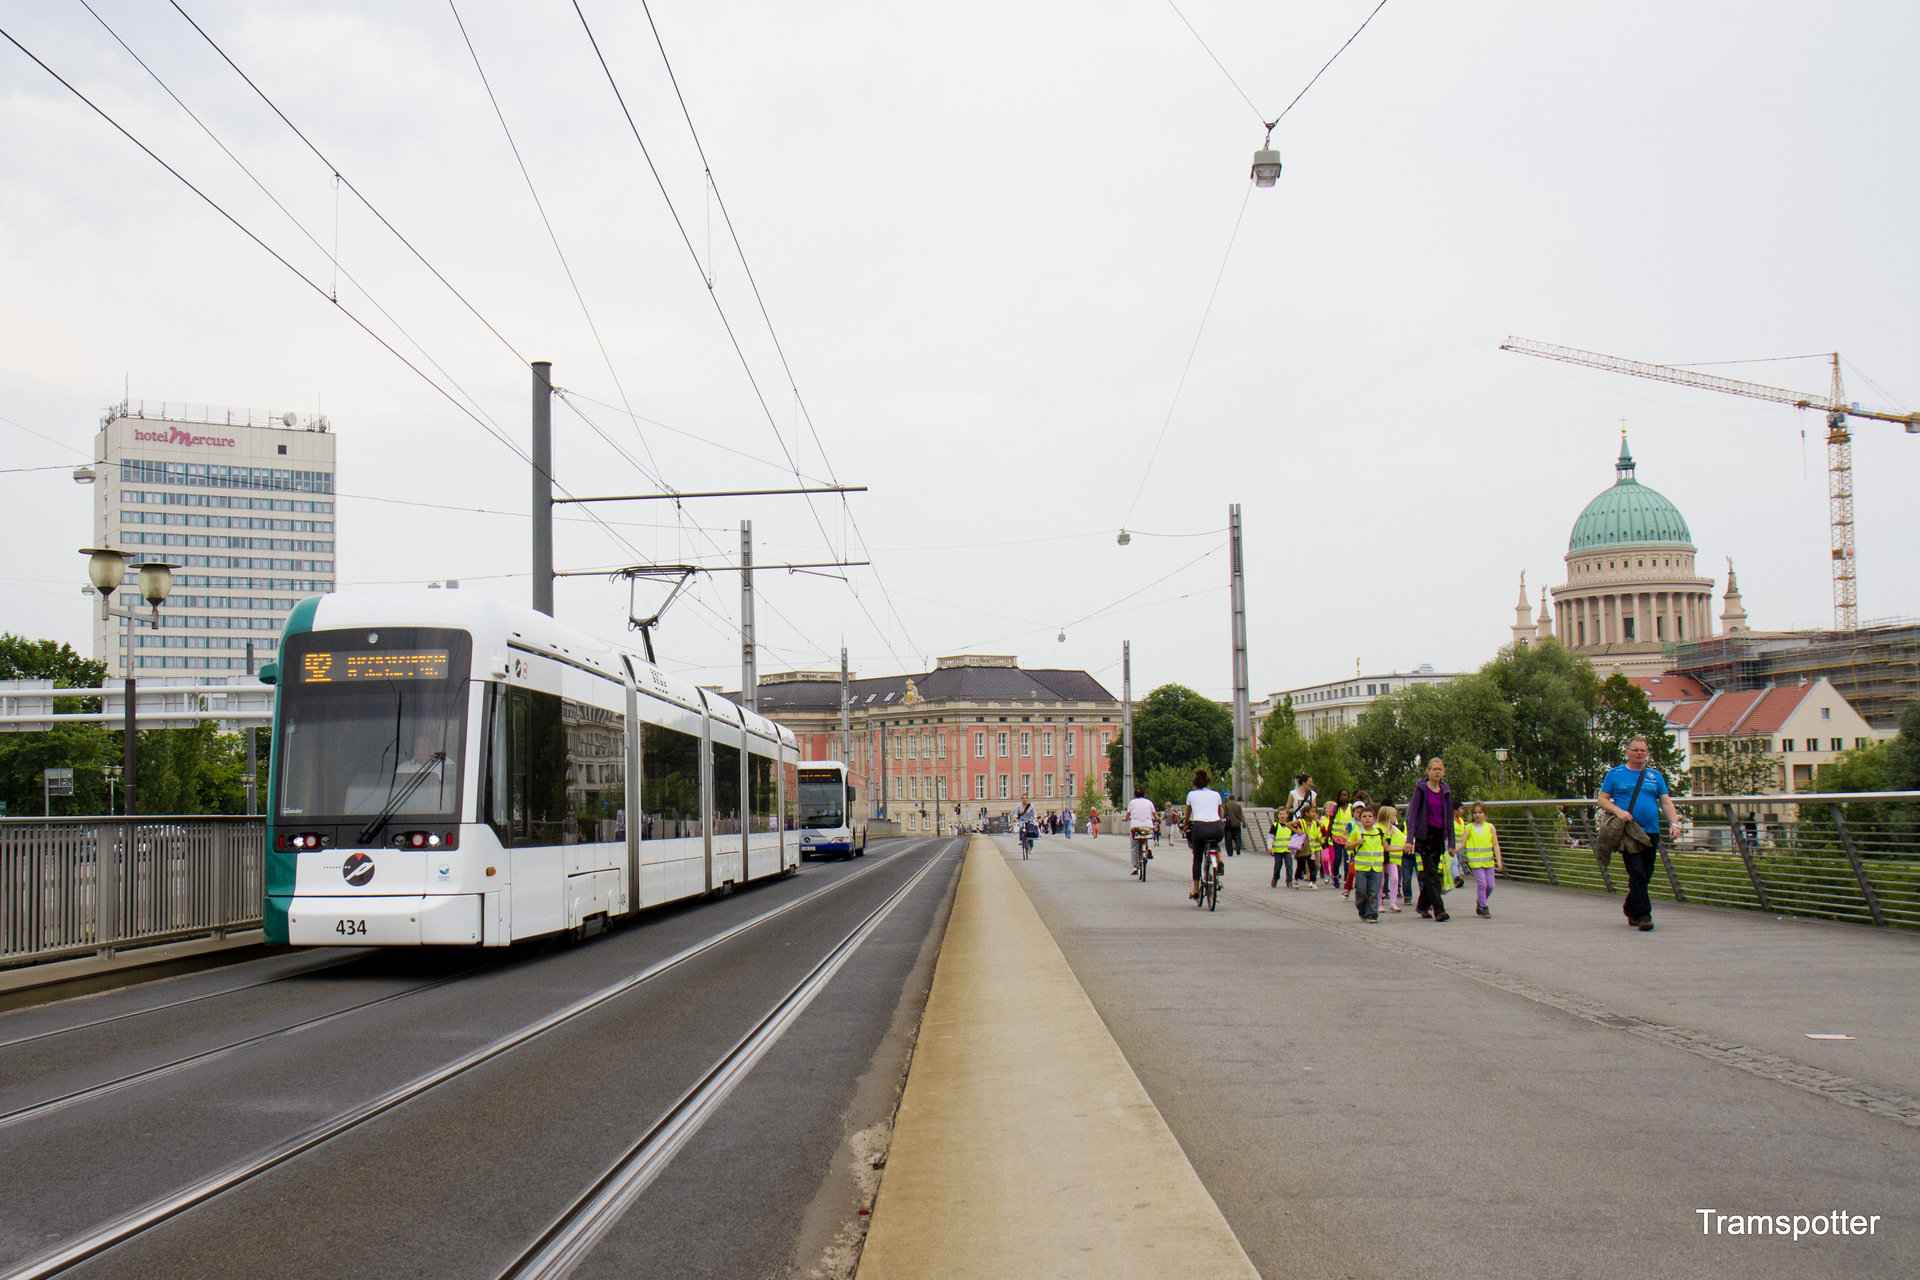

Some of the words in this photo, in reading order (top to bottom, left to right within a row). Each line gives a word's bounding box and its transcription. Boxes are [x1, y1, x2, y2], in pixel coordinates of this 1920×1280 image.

[134, 429, 168, 442] hotel
[169, 426, 235, 447] Mercure
[336, 919, 368, 935] 434
